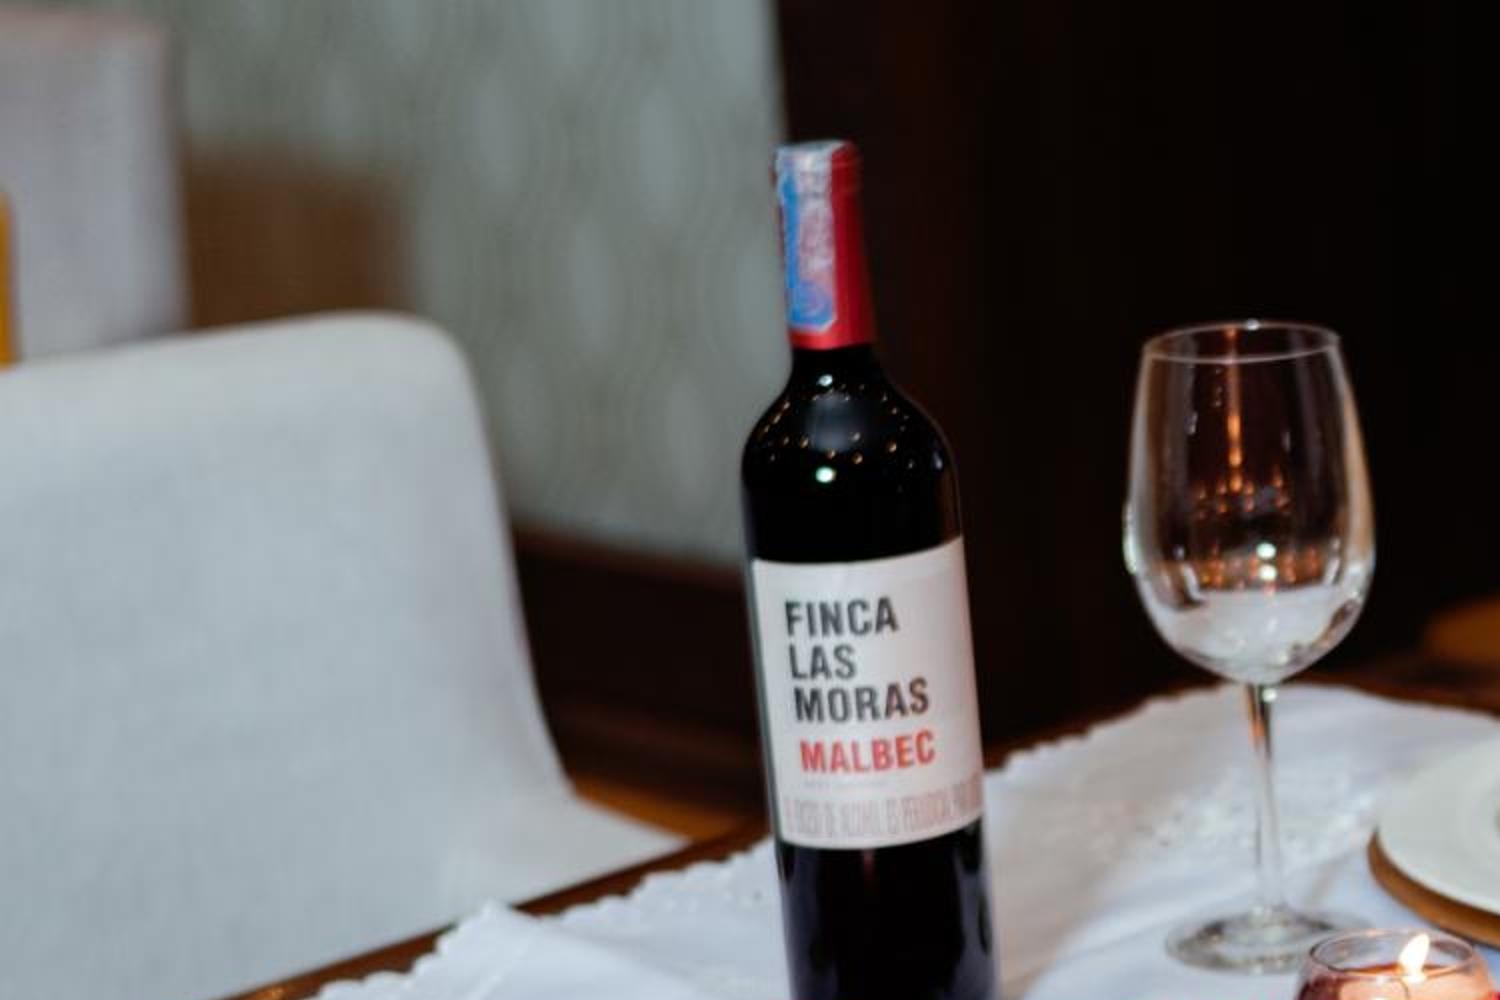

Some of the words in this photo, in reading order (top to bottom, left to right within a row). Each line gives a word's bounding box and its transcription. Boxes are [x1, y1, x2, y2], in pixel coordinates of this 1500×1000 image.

[785, 596, 899, 637] FINCA
[788, 644, 857, 680] LAS
[794, 676, 930, 722] MORAS
[799, 729, 936, 773] MALBEC
